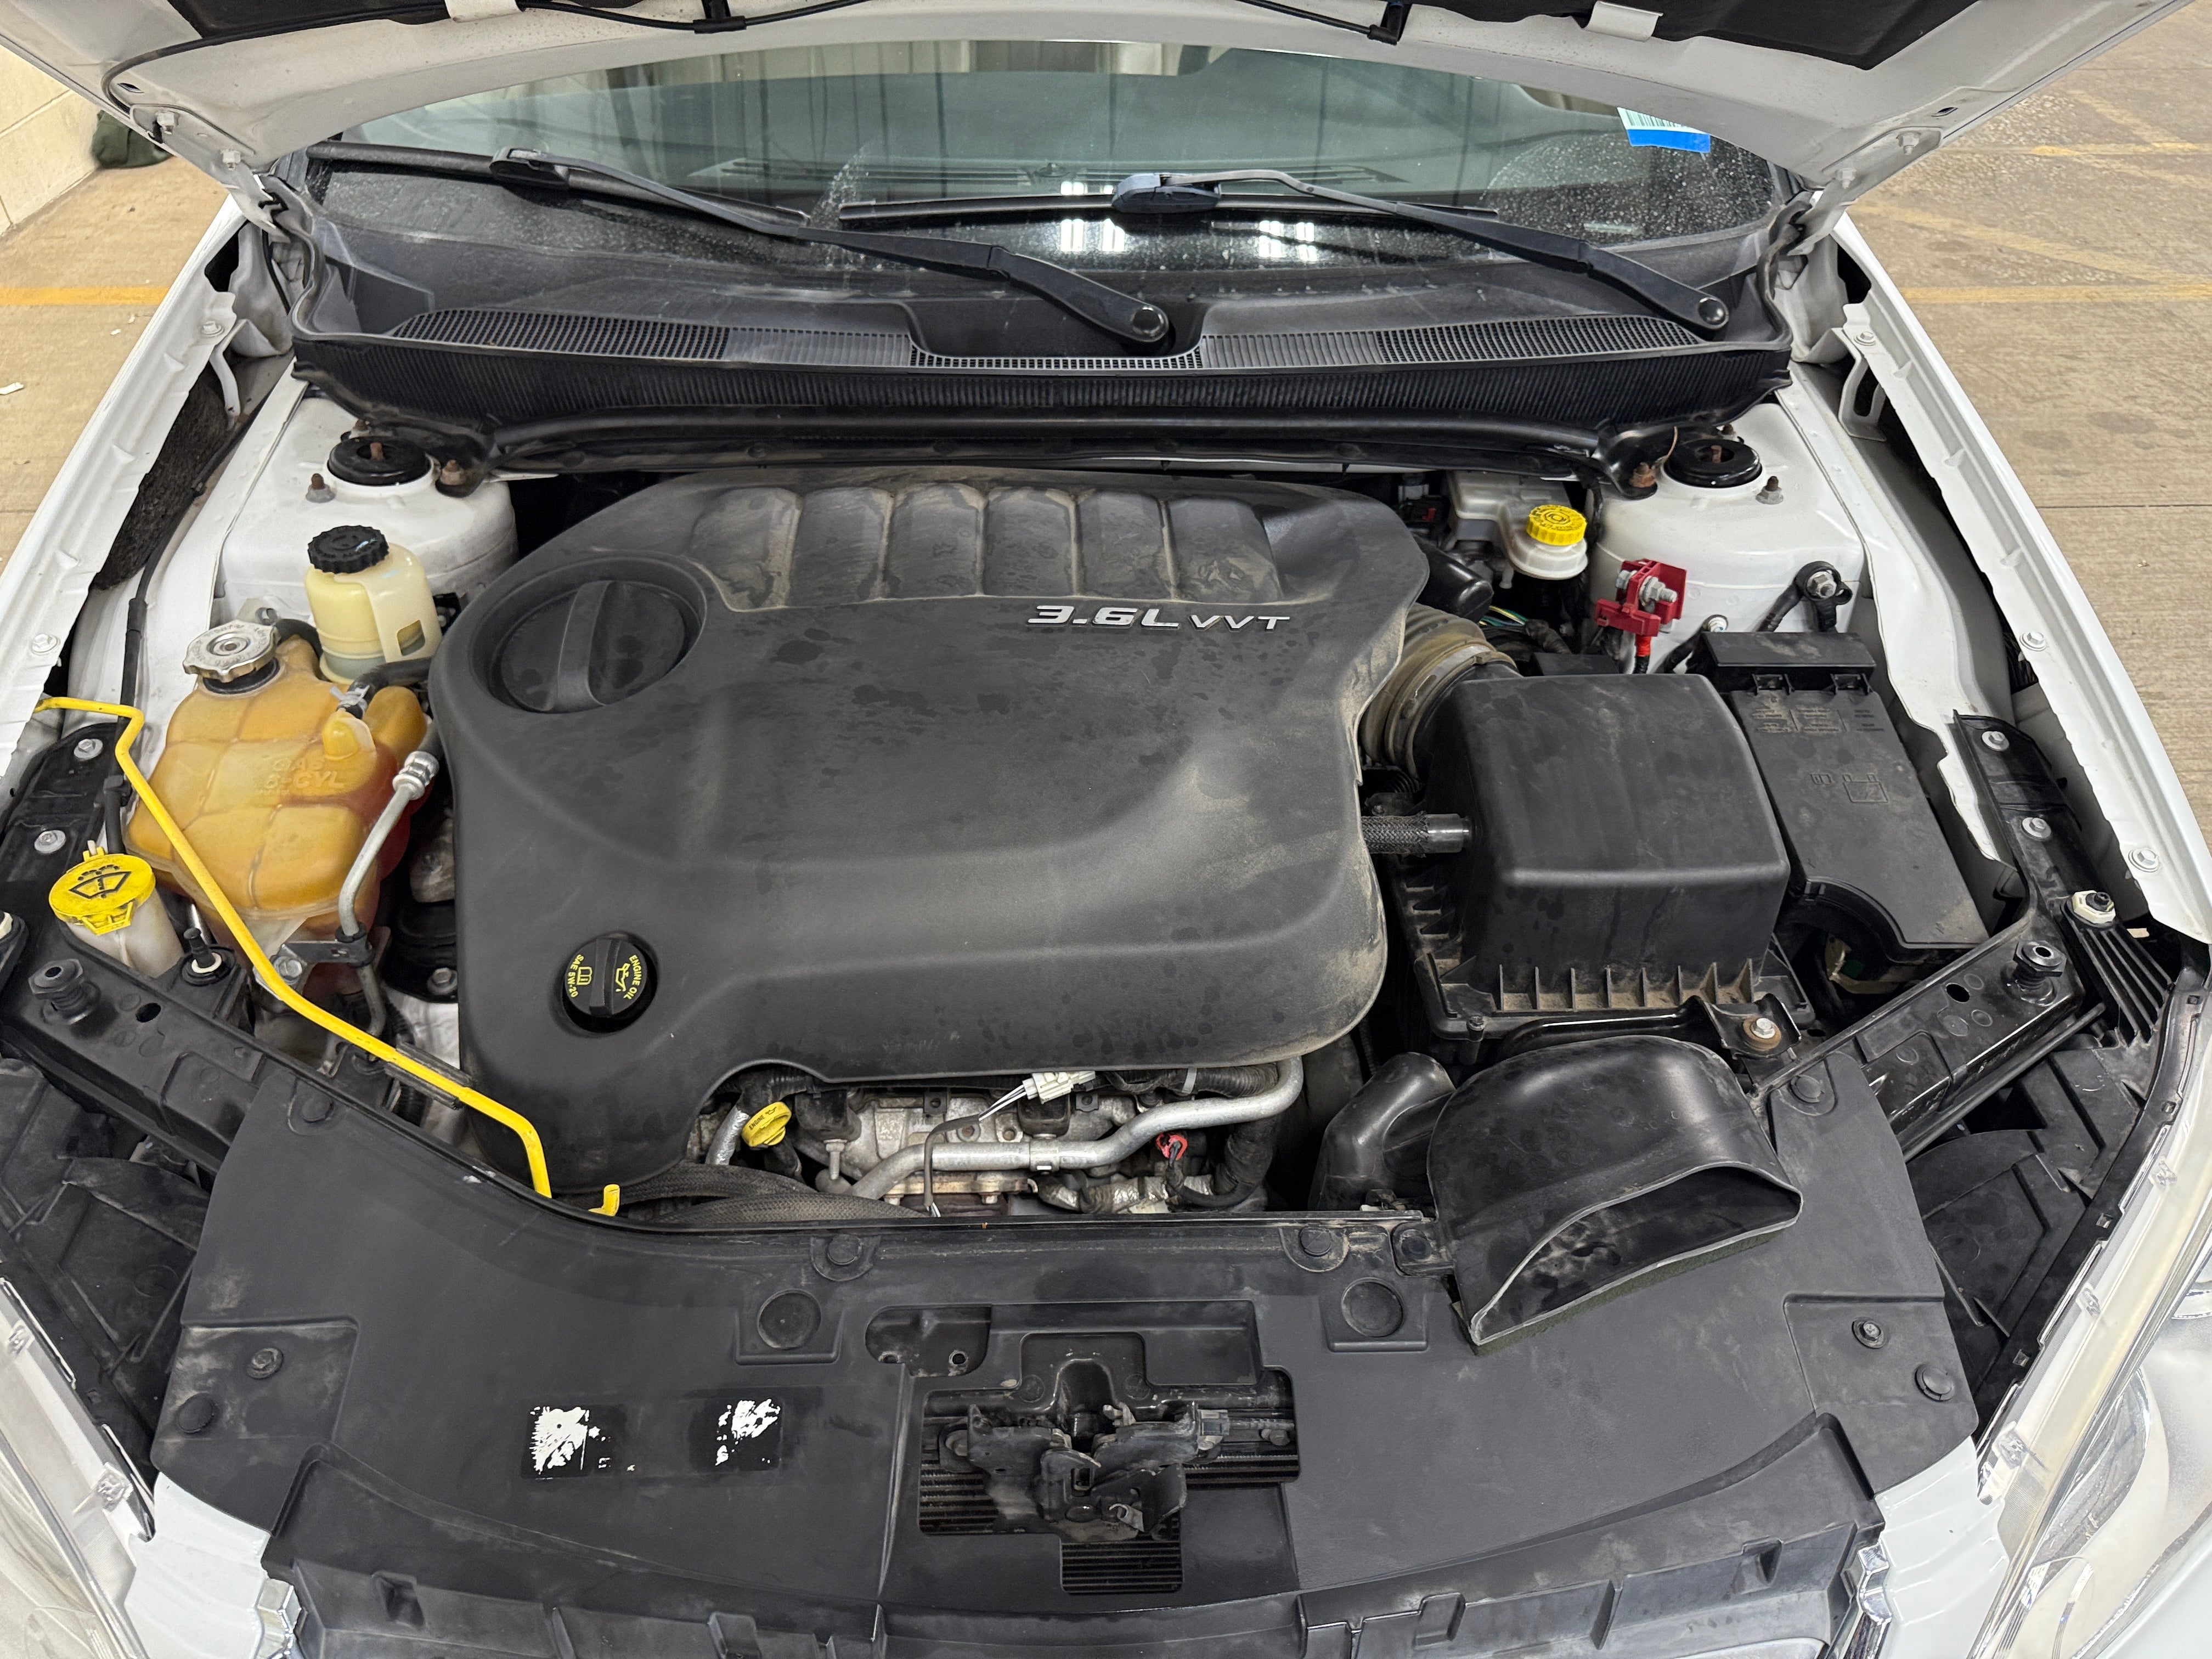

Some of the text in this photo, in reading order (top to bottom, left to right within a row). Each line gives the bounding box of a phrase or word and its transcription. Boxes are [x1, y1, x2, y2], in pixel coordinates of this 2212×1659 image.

[1028, 605, 1291, 630] 3.6L VVT
[568, 955, 584, 997] SAE 5W-20
[623, 955, 641, 999] ENGINE OIL
